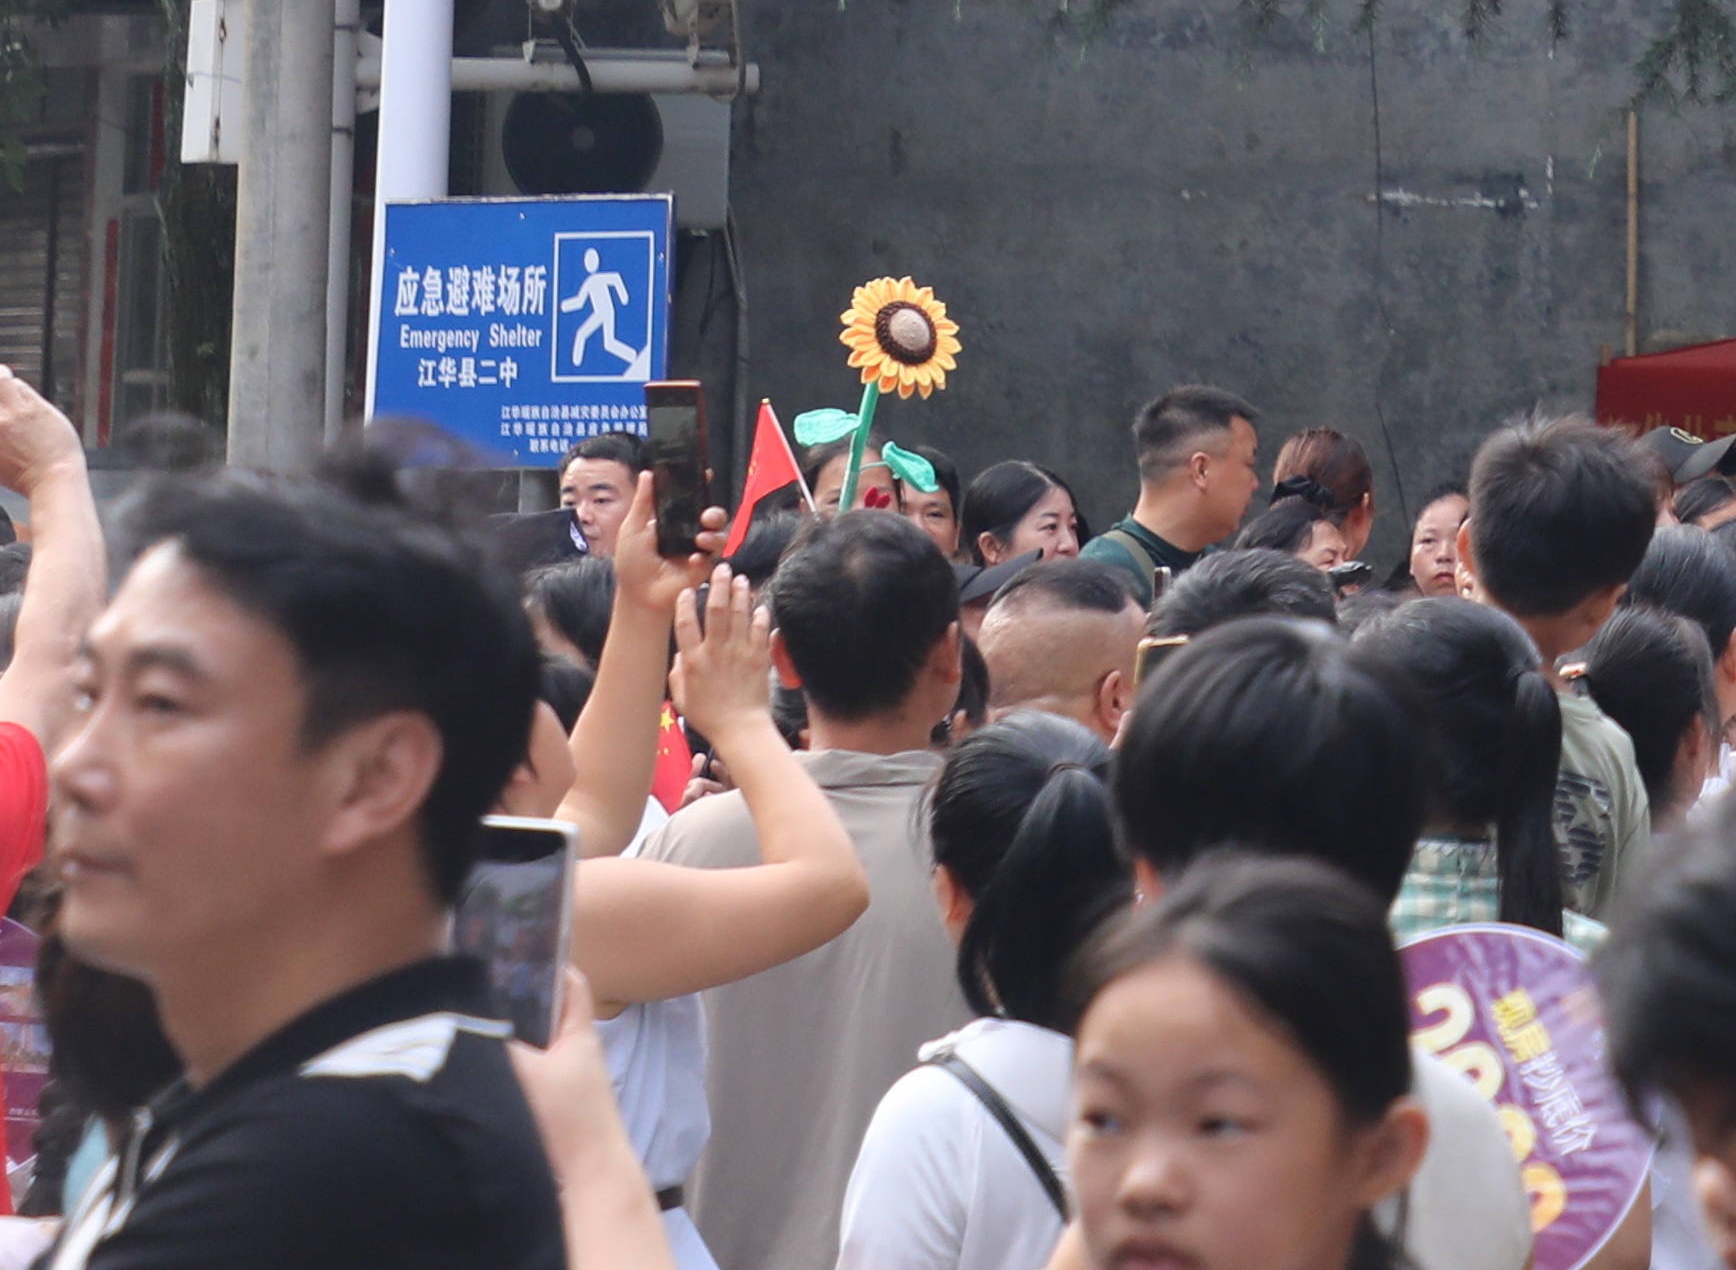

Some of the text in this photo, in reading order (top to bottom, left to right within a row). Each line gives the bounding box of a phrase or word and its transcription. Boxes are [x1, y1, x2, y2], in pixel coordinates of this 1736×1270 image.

[394, 264, 548, 318] 应急避难场所
[400, 322, 543, 353] Emergency Shelter
[418, 356, 519, 389] 江华县二中
